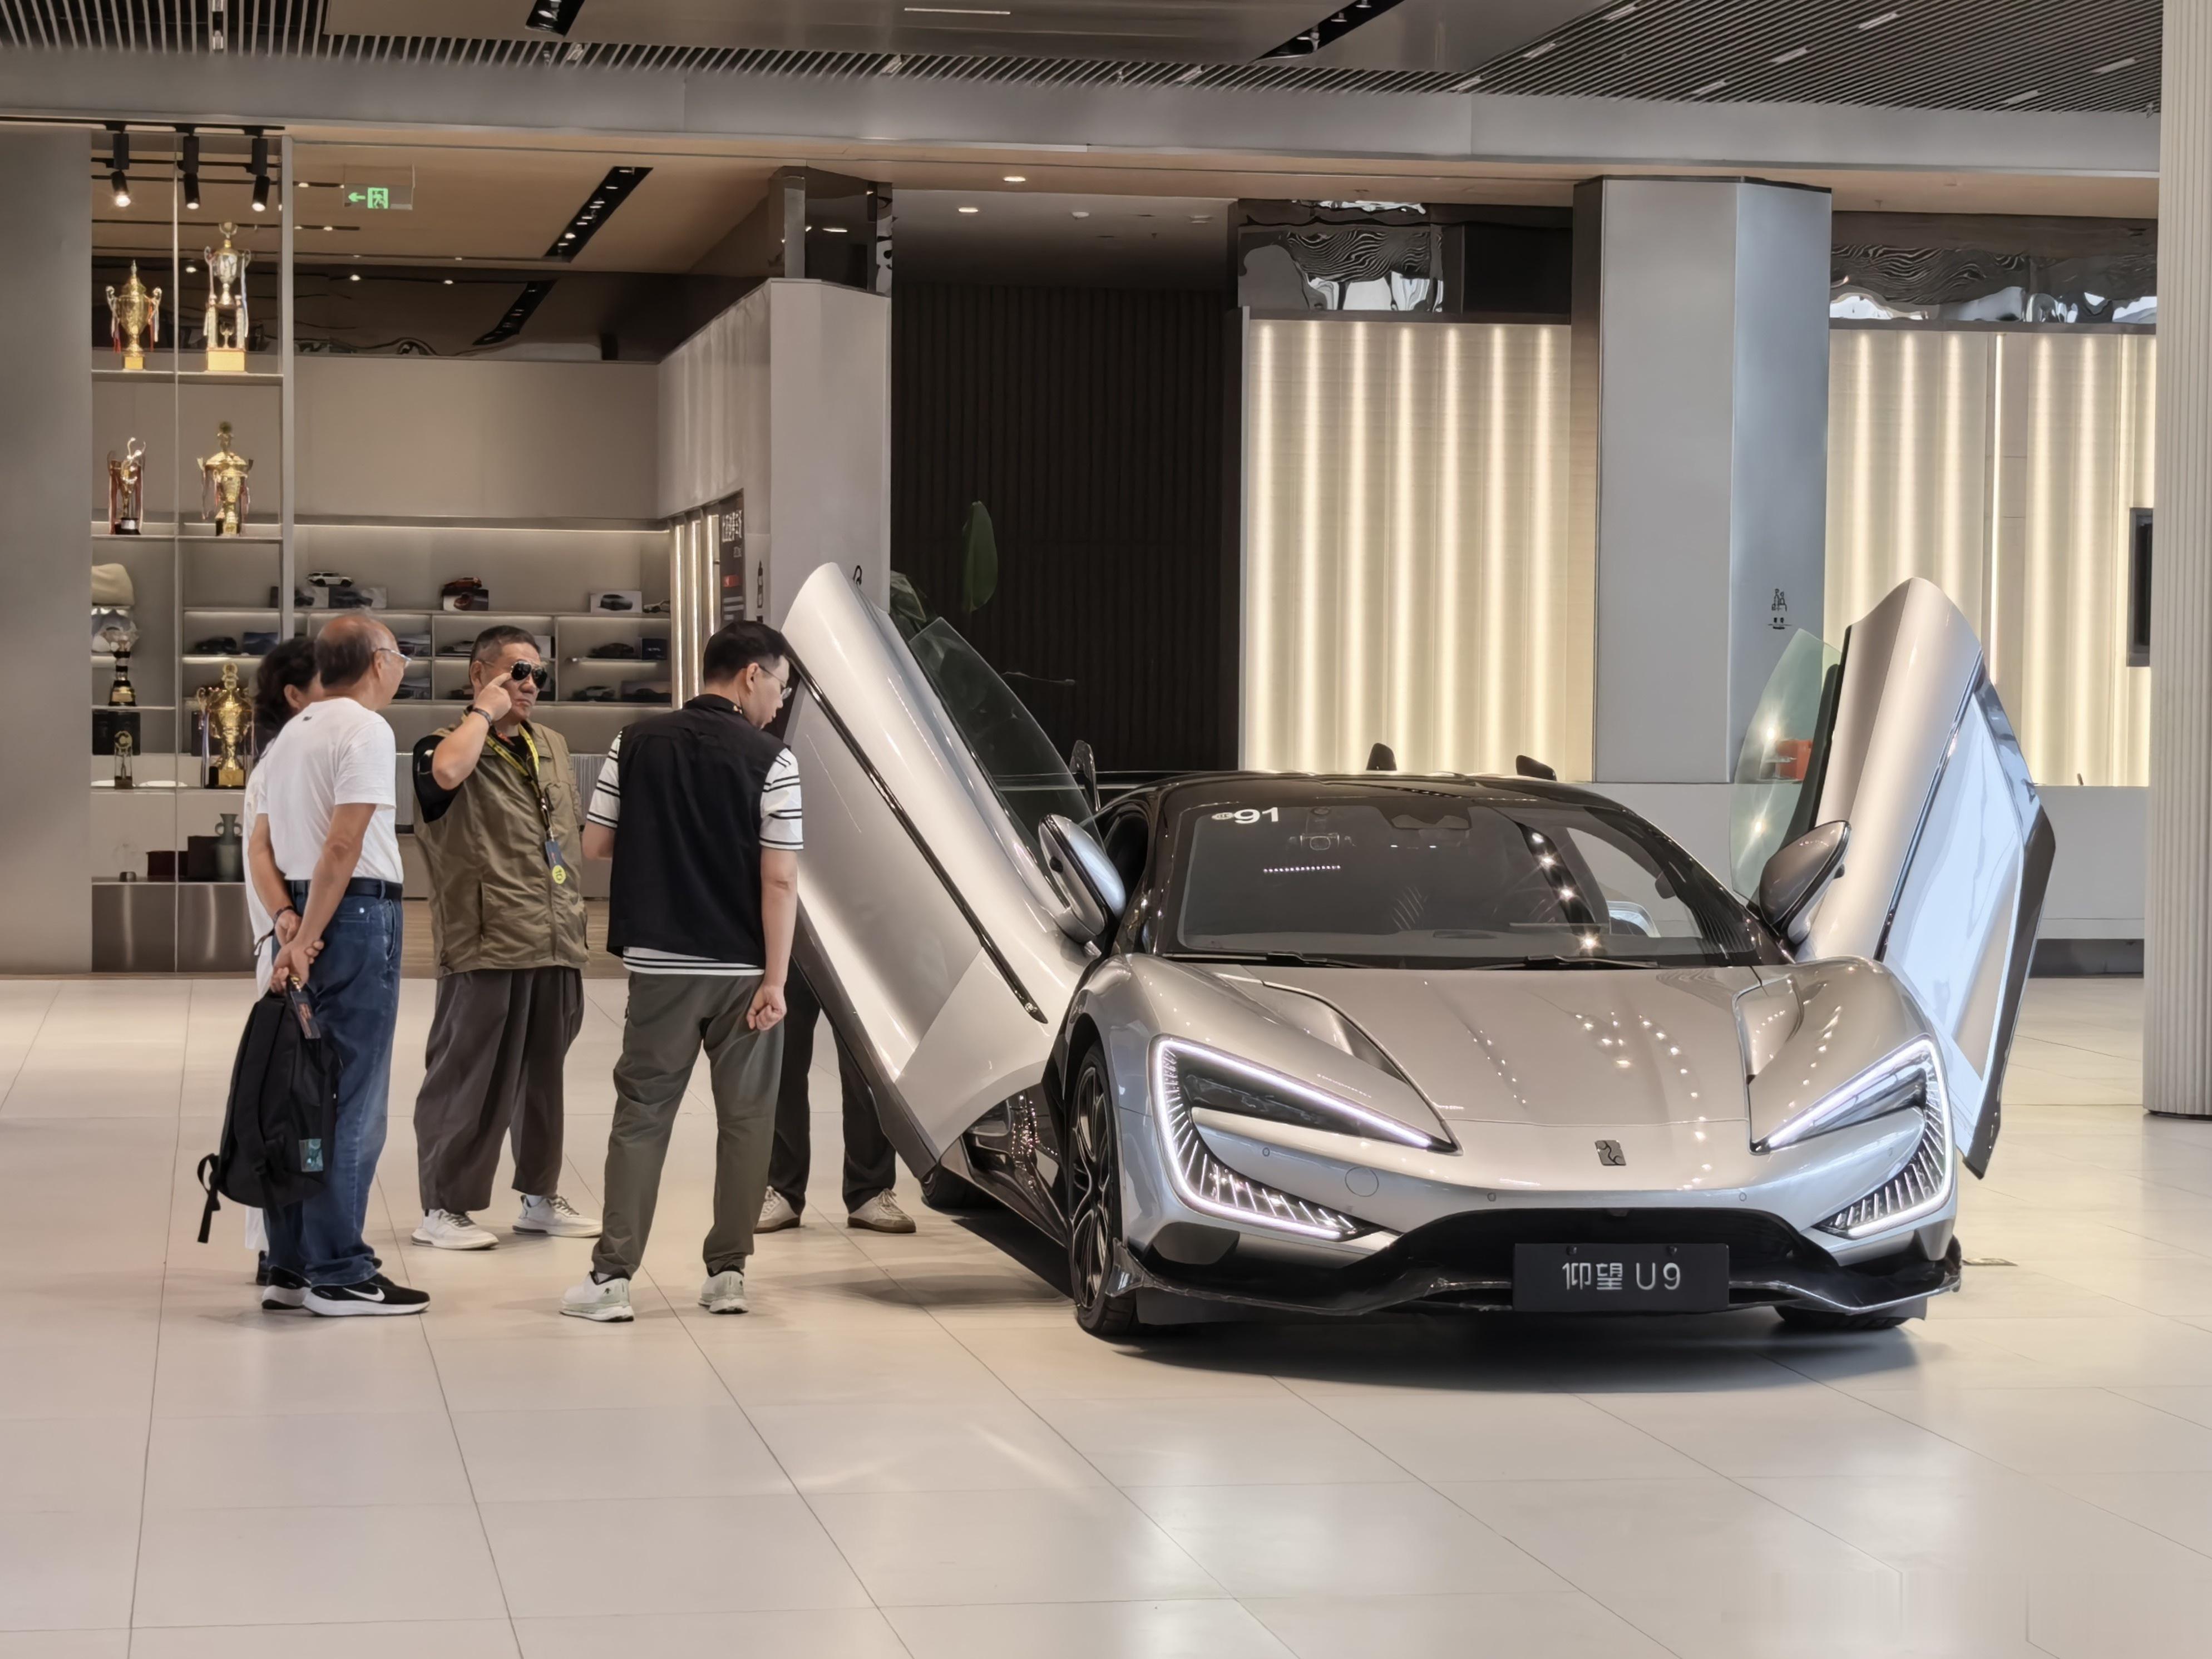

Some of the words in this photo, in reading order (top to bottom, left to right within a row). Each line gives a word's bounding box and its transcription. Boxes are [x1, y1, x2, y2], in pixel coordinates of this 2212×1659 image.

[1233, 807, 1279, 824] 91
[1562, 1262, 1623, 1290] 仰望
[1636, 1262, 1681, 1290] U9
